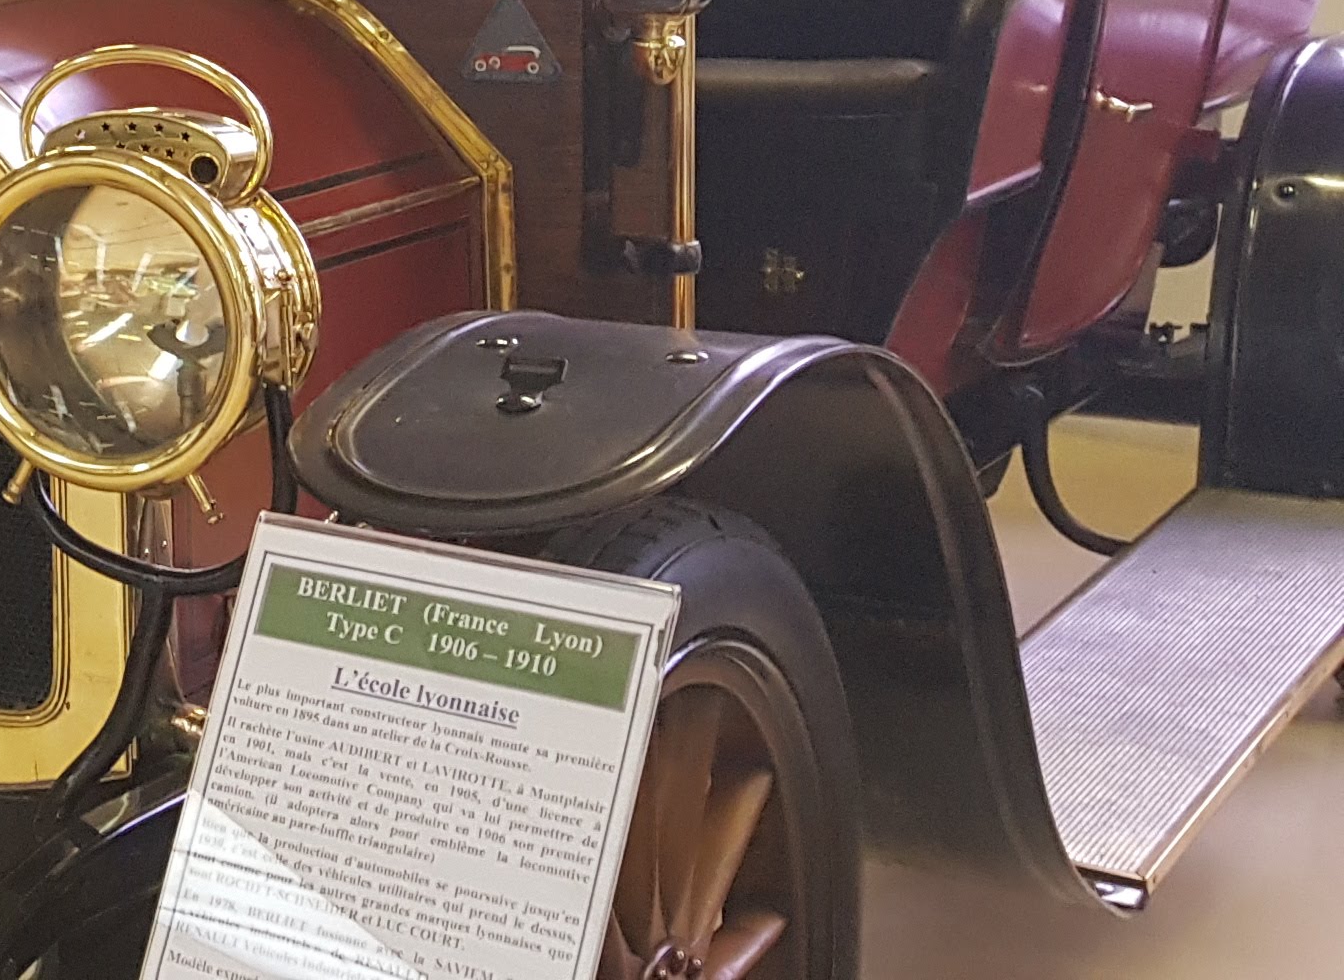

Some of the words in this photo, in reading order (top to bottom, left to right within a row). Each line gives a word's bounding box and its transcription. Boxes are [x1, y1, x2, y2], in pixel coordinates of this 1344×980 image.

[296, 575, 407, 615] BERLIET
[422, 602, 509, 636] (France
[533, 621, 603, 658] Lyon)
[326, 610, 379, 642] Type
[383, 624, 404, 645] C
[427, 632, 478, 661] 1906
[504, 648, 557, 676] 1910
[232, 695, 273, 713] voiture
[274, 706, 289, 717] en
[321, 713, 350, 731] dans
[351, 723, 368, 735] un
[370, 727, 410, 744] atelier
[411, 734, 427, 749] de
[429, 737, 441, 752] la
[443, 741, 531, 772] Croix-Rousse.
[236, 676, 252, 691] Le
[254, 682, 280, 697] plus
[285, 688, 345, 713] important
[349, 705, 427, 731] constructeur
[431, 720, 484, 744] lyonnais
[534, 747, 549, 758] sa
[554, 751, 616, 774] première
[333, 666, 411, 699] L'école
[415, 683, 520, 725] lyonnaise
[217, 746, 283, 773] l'American
[365, 782, 423, 810] Company
[431, 801, 453, 815] qui
[460, 807, 476, 819] va
[483, 810, 501, 825] lui
[507, 819, 574, 843] permettre
[580, 834, 598, 849] de
[221, 733, 236, 744] en
[245, 736, 275, 755] 1901,
[283, 748, 312, 762] mais
[320, 755, 349, 771] c'est
[356, 762, 369, 777] la
[378, 770, 414, 789] vente,
[423, 782, 439, 793] en
[449, 784, 481, 805] 1905,
[490, 795, 529, 814] d'une
[538, 805, 583, 827] licence
[591, 820, 602, 833] à
[226, 714, 237, 728] Il
[239, 720, 283, 739] rachète
[285, 728, 325, 749] l'usine
[405, 759, 417, 771] et
[515, 783, 524, 796] à
[530, 785, 606, 814] Montplaisir
[209, 780, 255, 800] camion.
[263, 793, 278, 806] (il
[285, 799, 339, 821] adoptera
[348, 814, 379, 831] alors
[388, 825, 420, 841] pour
[428, 836, 486, 857] emblème
[495, 849, 508, 864] la
[518, 854, 590, 884] locomotive
[213, 762, 278, 788] développer
[282, 781, 303, 795] son
[307, 788, 352, 806] activité
[356, 800, 369, 811] et
[373, 802, 390, 816] de
[393, 809, 449, 831] produire
[454, 824, 470, 836] en
[477, 826, 506, 844] 1906
[512, 838, 535, 851] son
[538, 845, 594, 866] premier
[270, 813, 286, 825] au
[287, 817, 355, 842] pare-buffle
[356, 833, 436, 864] triangulaire)
[256, 831, 269, 845] la
[272, 837, 339, 864] production
[343, 854, 430, 887] d'automobiles
[434, 880, 449, 891] se
[453, 884, 517, 910] poursuive
[520, 900, 580, 926] jusqu'en
[292, 858, 313, 874] des
[318, 866, 372, 889] véhicules
[377, 882, 437, 906] utilitaires
[441, 899, 464, 914] qui
[467, 906, 508, 926] prend
[512, 915, 525, 929] le
[529, 920, 576, 946] dessus,
[298, 876, 315, 891] les
[318, 884, 357, 904] autres
[360, 896, 410, 917] grandes
[414, 911, 471, 934] marques
[475, 923, 542, 953] lyonnaises
[546, 947, 573, 961] que
[166, 948, 213, 974] Modèle
[360, 914, 373, 926] et
[375, 914, 403, 933] LUC
[412, 950, 425, 966] la
